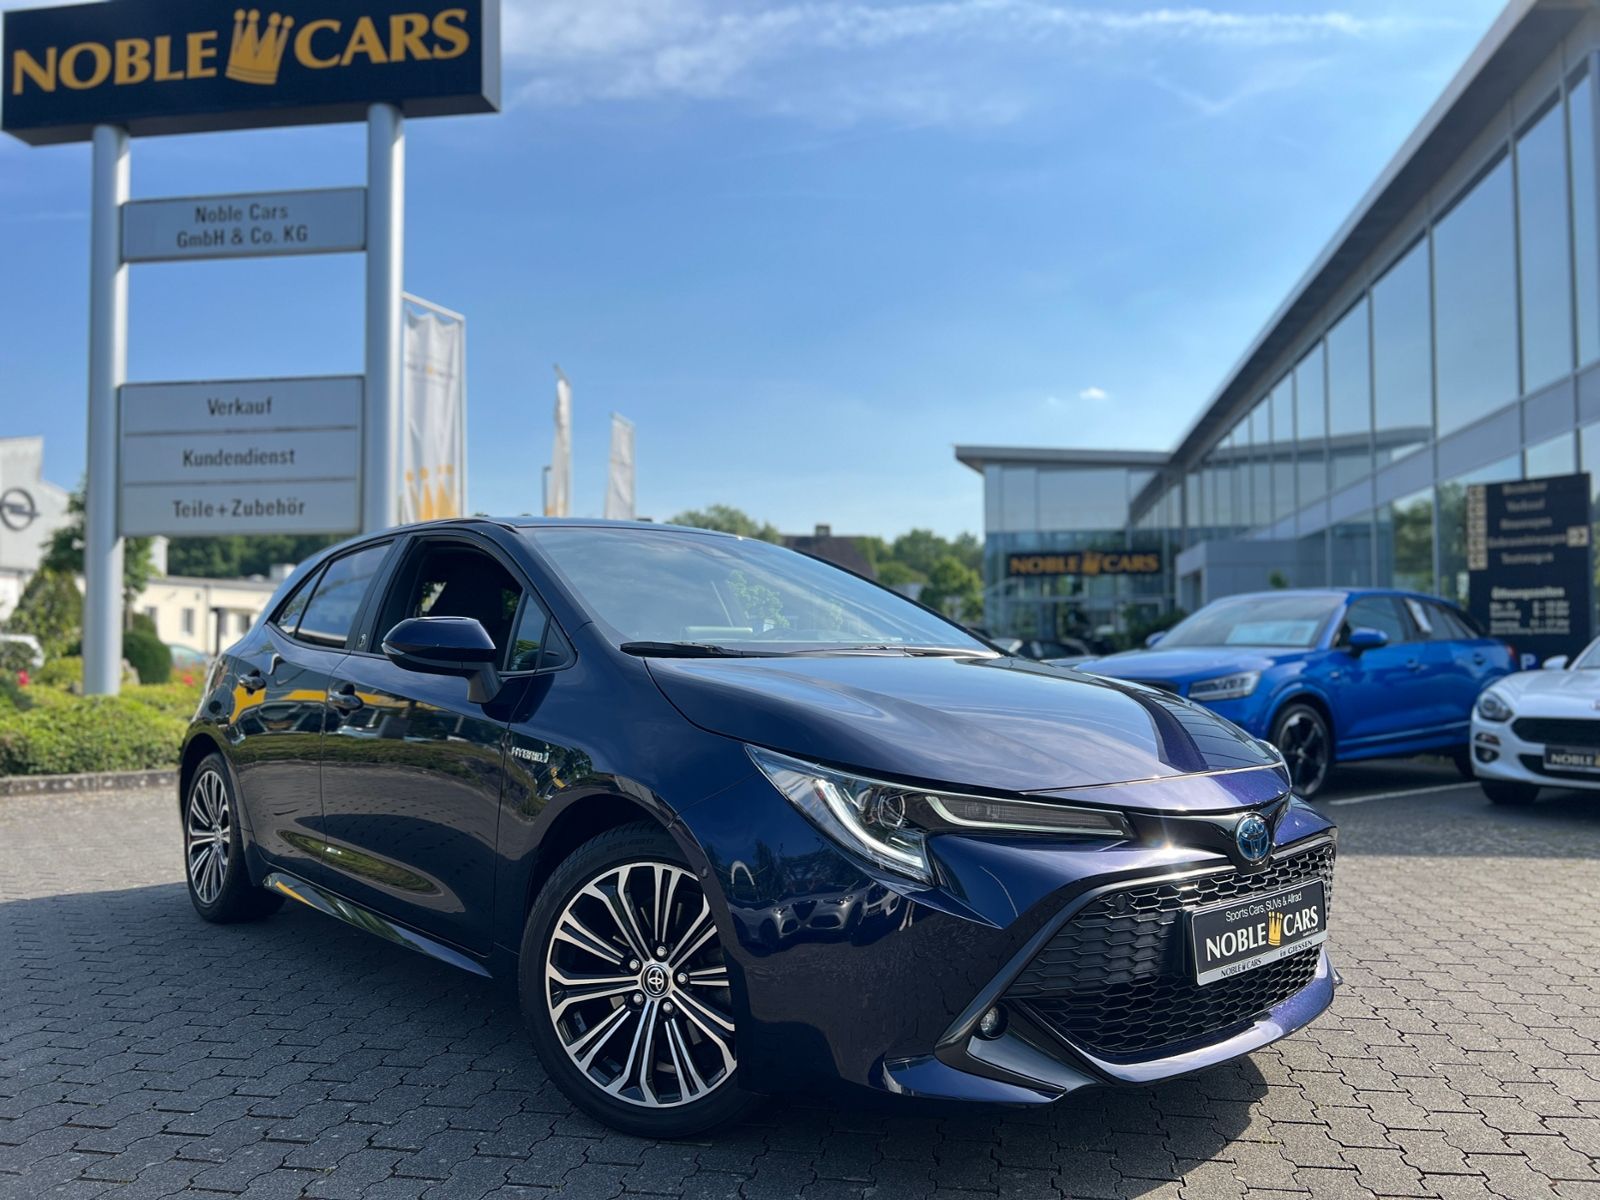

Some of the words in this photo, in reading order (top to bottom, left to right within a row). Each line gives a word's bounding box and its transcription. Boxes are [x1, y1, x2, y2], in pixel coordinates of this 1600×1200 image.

[12, 31, 219, 95] NOBLE
[294, 9, 471, 69] CARS
[195, 205, 243, 224] Noble
[249, 204, 289, 221] Cars
[177, 229, 225, 249] GmbH
[231, 228, 244, 246] &
[250, 226, 278, 246] Co.
[283, 224, 308, 244] KG
[208, 396, 273, 416] Verkauf
[183, 448, 295, 468] Kundendienst
[1010, 556, 1078, 574] NOBLE
[1103, 554, 1158, 573] CARS
[511, 746, 544, 762] HYBRID
[1226, 909, 1249, 922] Sports
[1266, 899, 1281, 911] SUVs
[1282, 896, 1288, 906] &
[1288, 892, 1303, 904] Allrad
[1206, 923, 1267, 961] NOBLE
[1283, 905, 1318, 937] CARS
[1221, 964, 1241, 977] NOBLE
[1247, 957, 1262, 969] CARS
